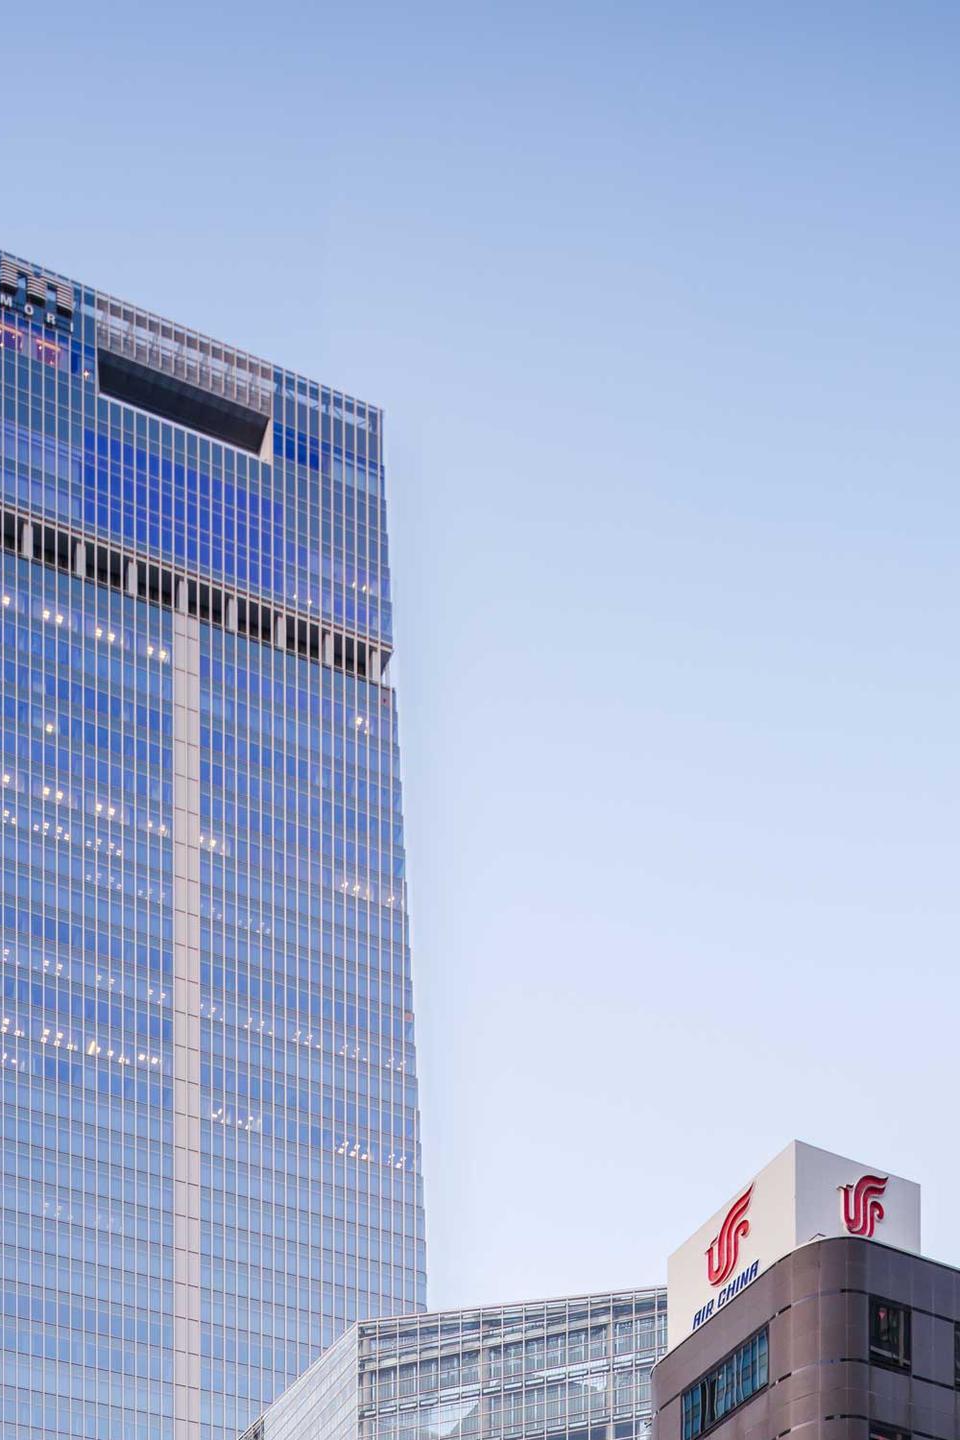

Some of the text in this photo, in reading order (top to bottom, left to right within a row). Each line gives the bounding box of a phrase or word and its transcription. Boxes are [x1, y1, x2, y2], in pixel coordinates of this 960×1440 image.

[0, 293, 74, 333] MORI
[693, 1259, 759, 1330] AIR CHINA
